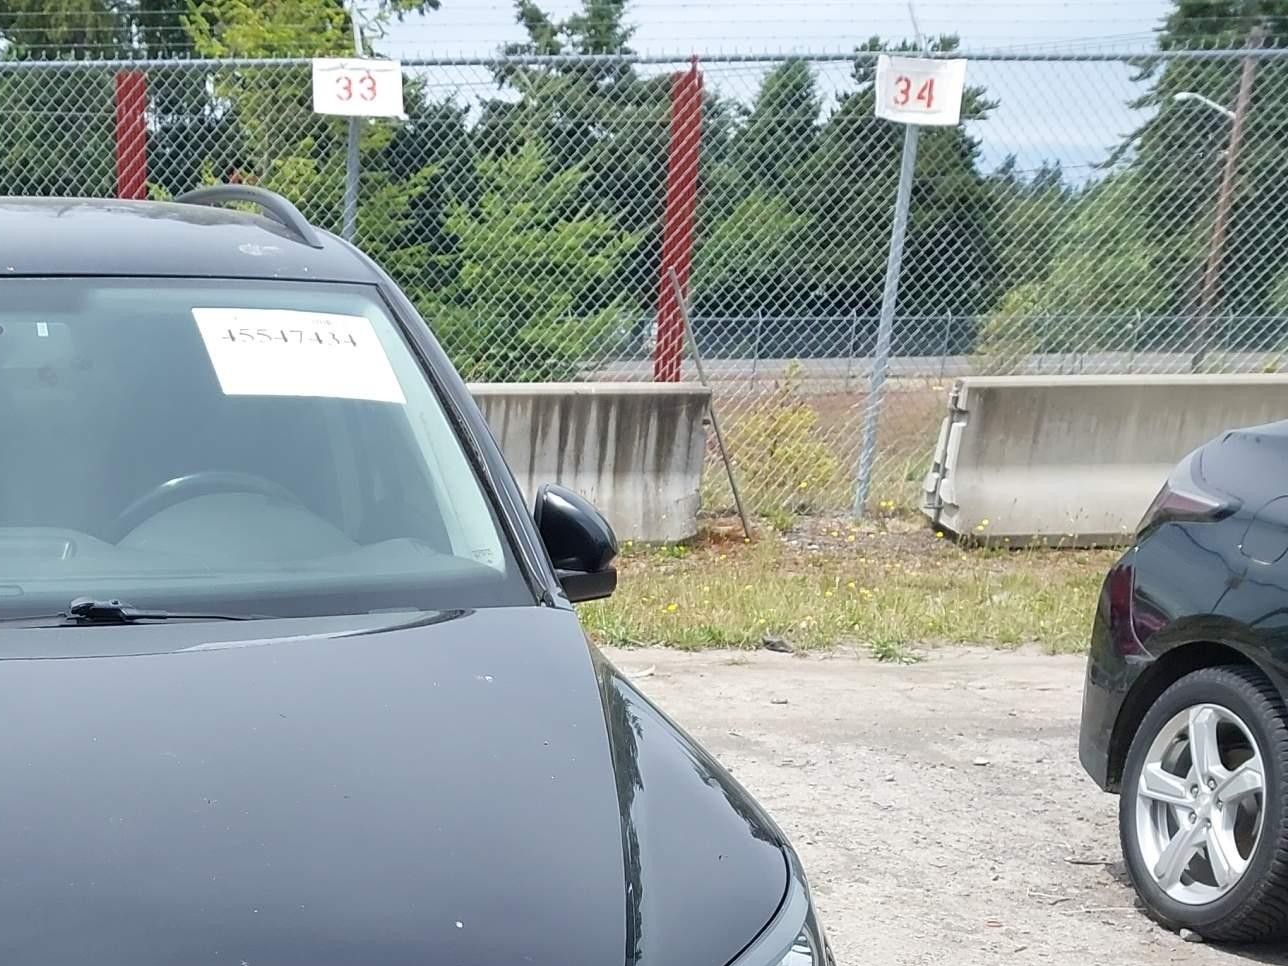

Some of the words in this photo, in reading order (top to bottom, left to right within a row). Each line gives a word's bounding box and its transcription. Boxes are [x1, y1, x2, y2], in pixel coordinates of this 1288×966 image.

[335, 76, 377, 101] 33
[894, 76, 934, 108] 34
[222, 328, 357, 347] 45547434
